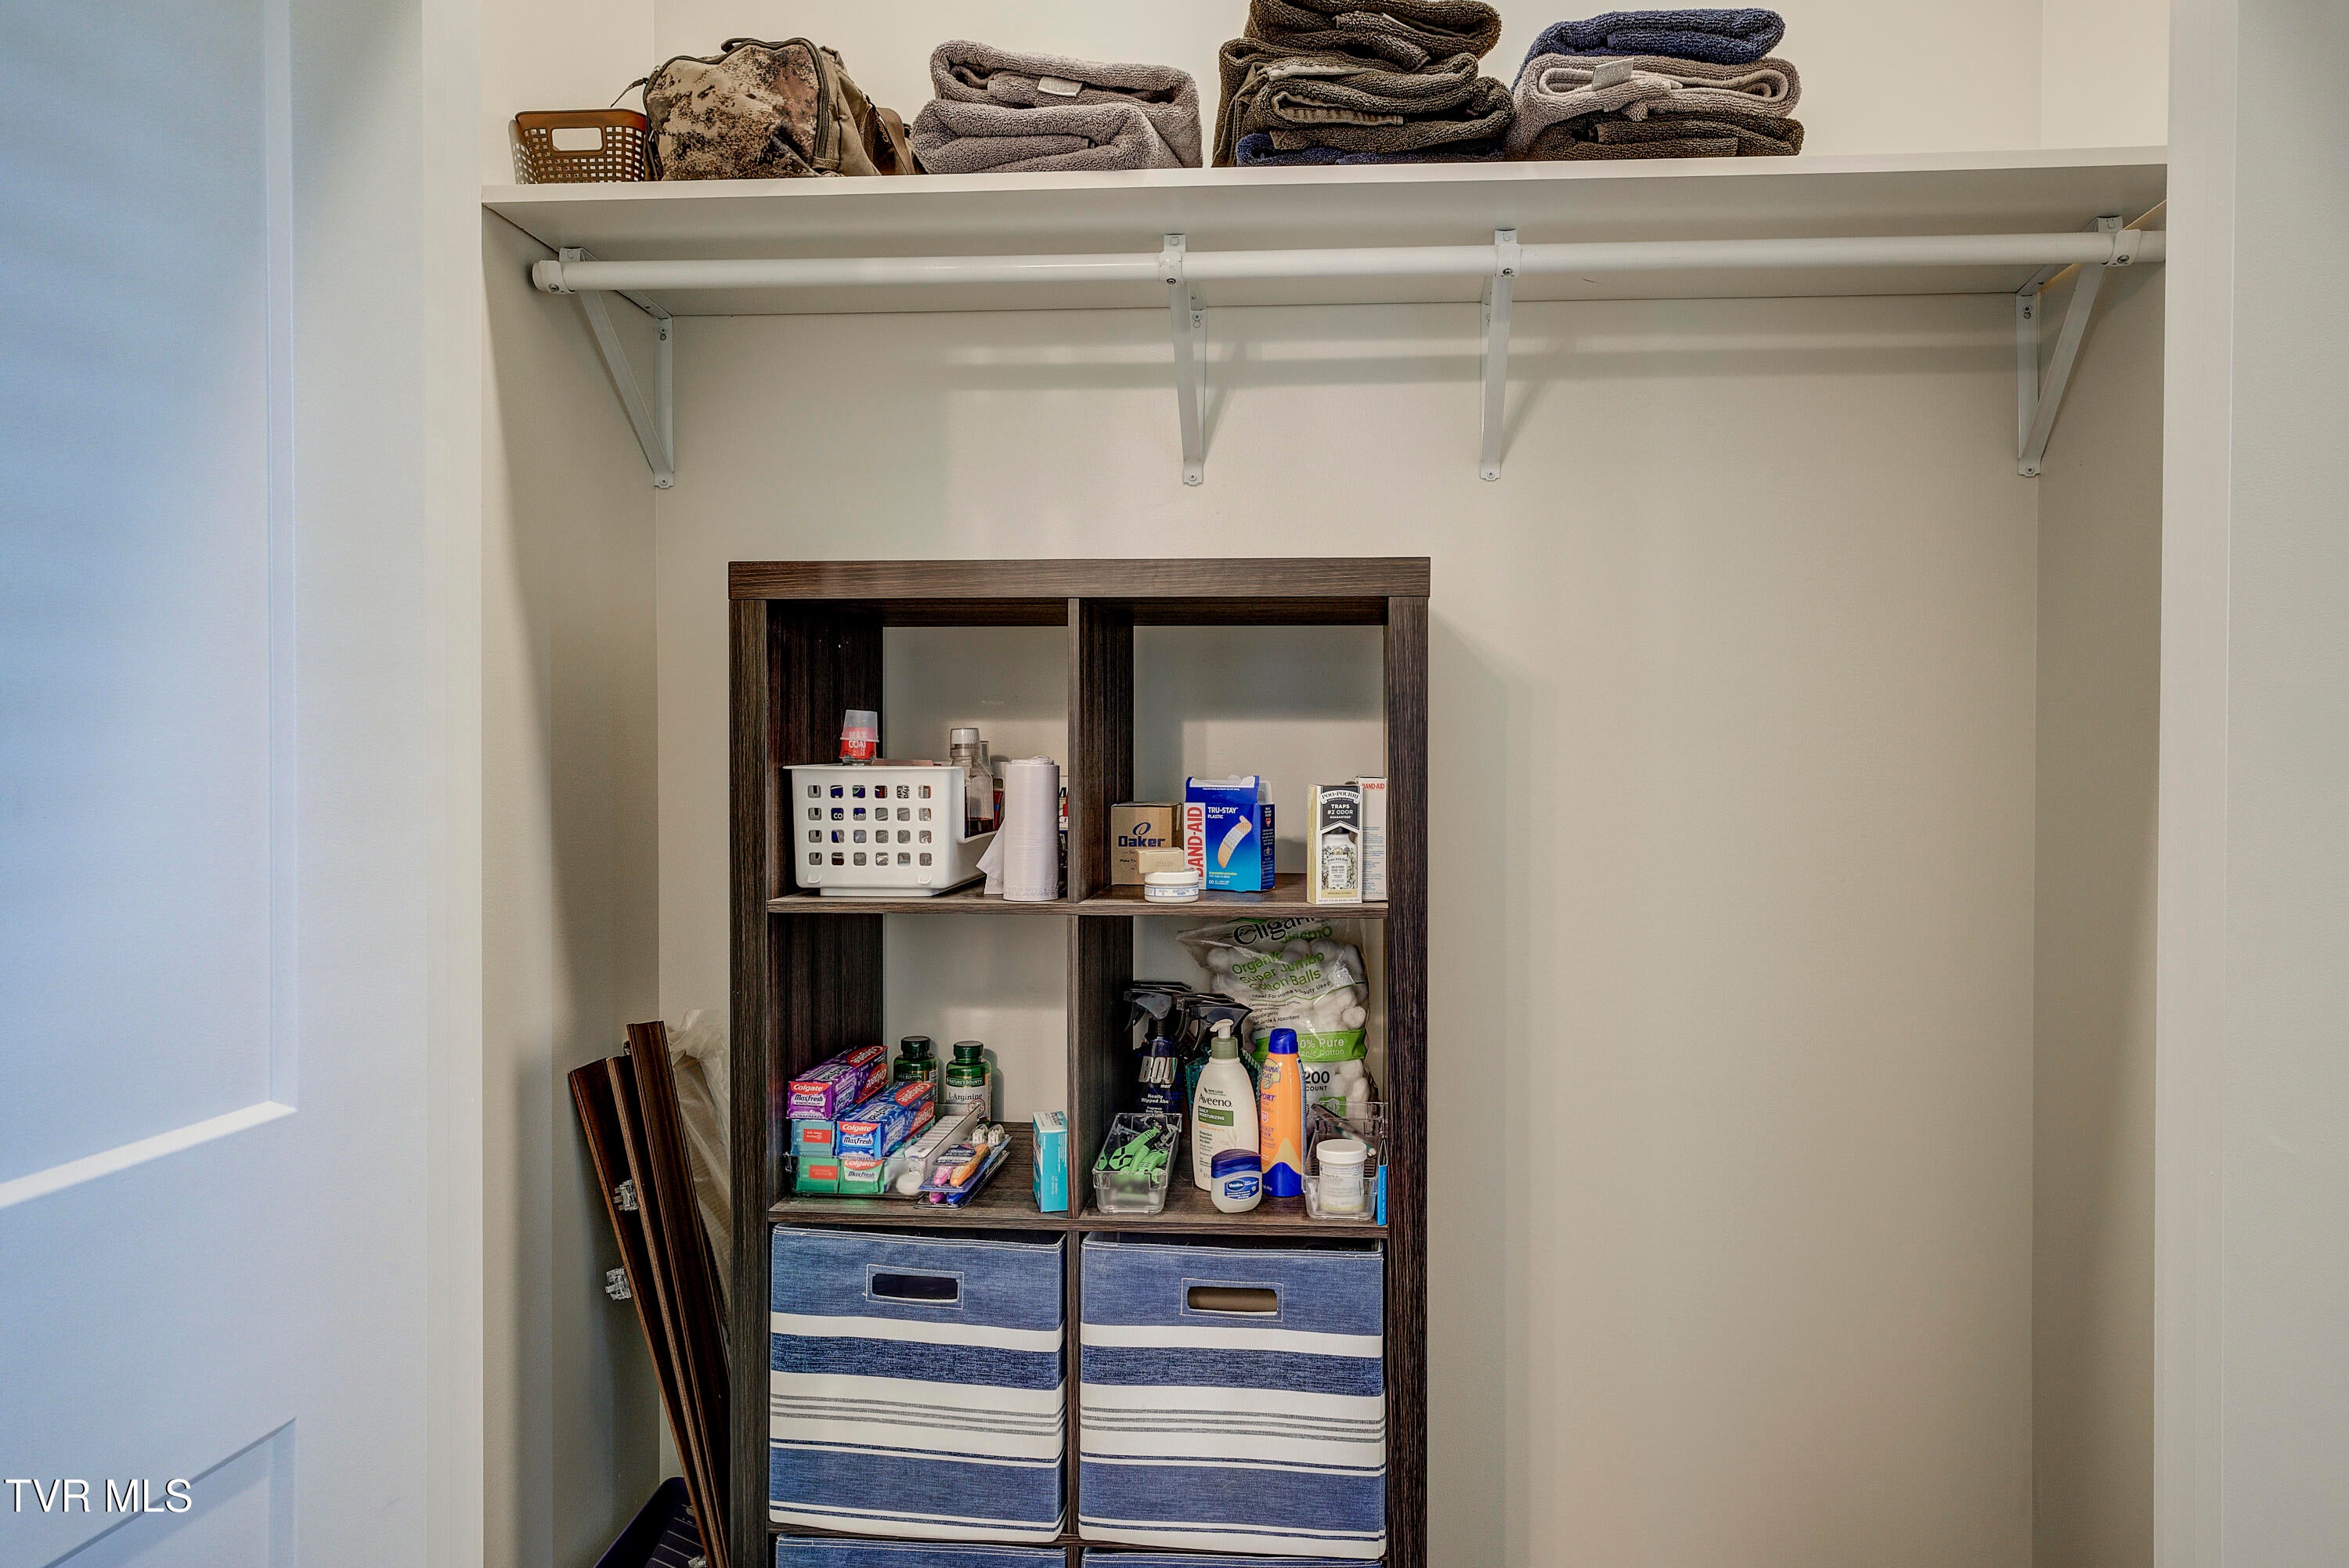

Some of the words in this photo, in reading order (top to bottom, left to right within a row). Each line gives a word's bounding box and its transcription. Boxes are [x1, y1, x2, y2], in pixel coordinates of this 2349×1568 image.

[1321, 790, 1359, 800] POO-POURRI
[1232, 950, 1283, 975] Organic
[1239, 968, 1276, 984] Super
[1280, 952, 1325, 972] Jumbo
[1289, 969, 1322, 986] Balls
[1318, 1038, 1344, 1047] Pure
[1138, 1055, 1178, 1084] BOD
[1304, 1070, 1330, 1084] 200
[793, 1083, 824, 1093] Colgate
[897, 1082, 930, 1103] Colgate
[794, 1094, 824, 1102] MaxFresh
[948, 1091, 983, 1101] L-Arginine
[1198, 1092, 1232, 1108] Aveeno
[842, 1123, 872, 1132] Colgate
[844, 1159, 876, 1168] Colgate
